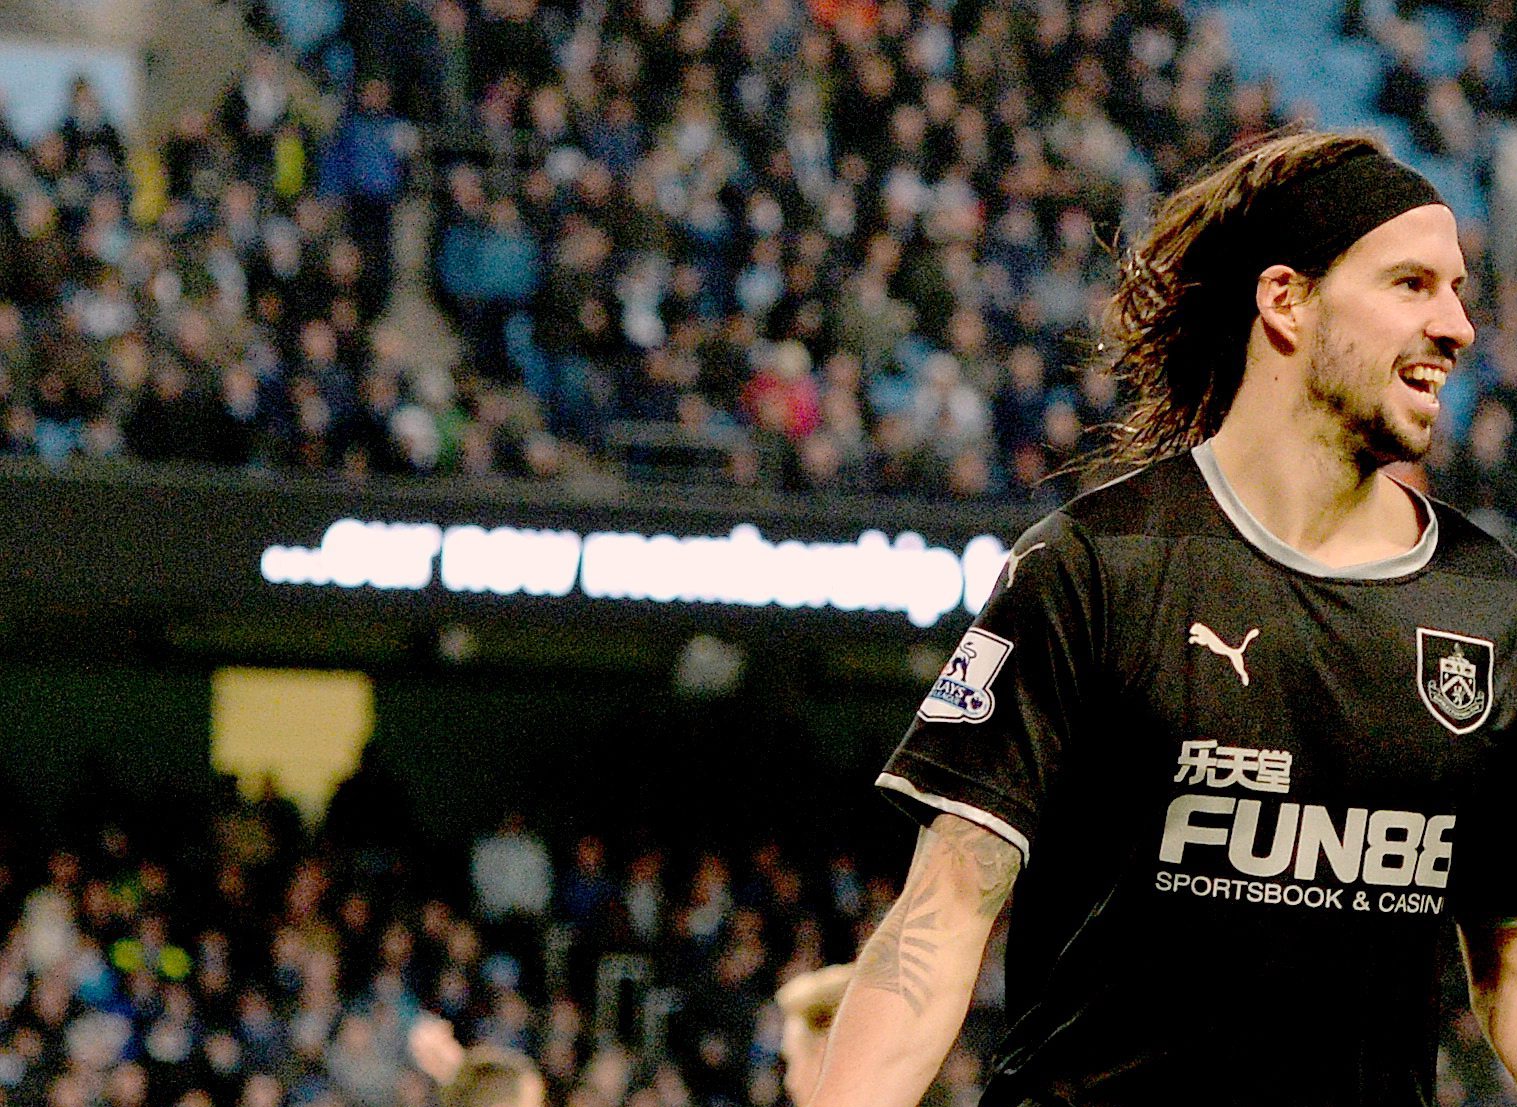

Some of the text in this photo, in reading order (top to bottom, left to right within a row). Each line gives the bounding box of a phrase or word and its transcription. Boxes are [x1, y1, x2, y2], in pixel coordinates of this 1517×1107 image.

[1174, 739, 1293, 793] 乐天堂
[1155, 871, 1445, 914] SPORTSBOOK & CASIN
